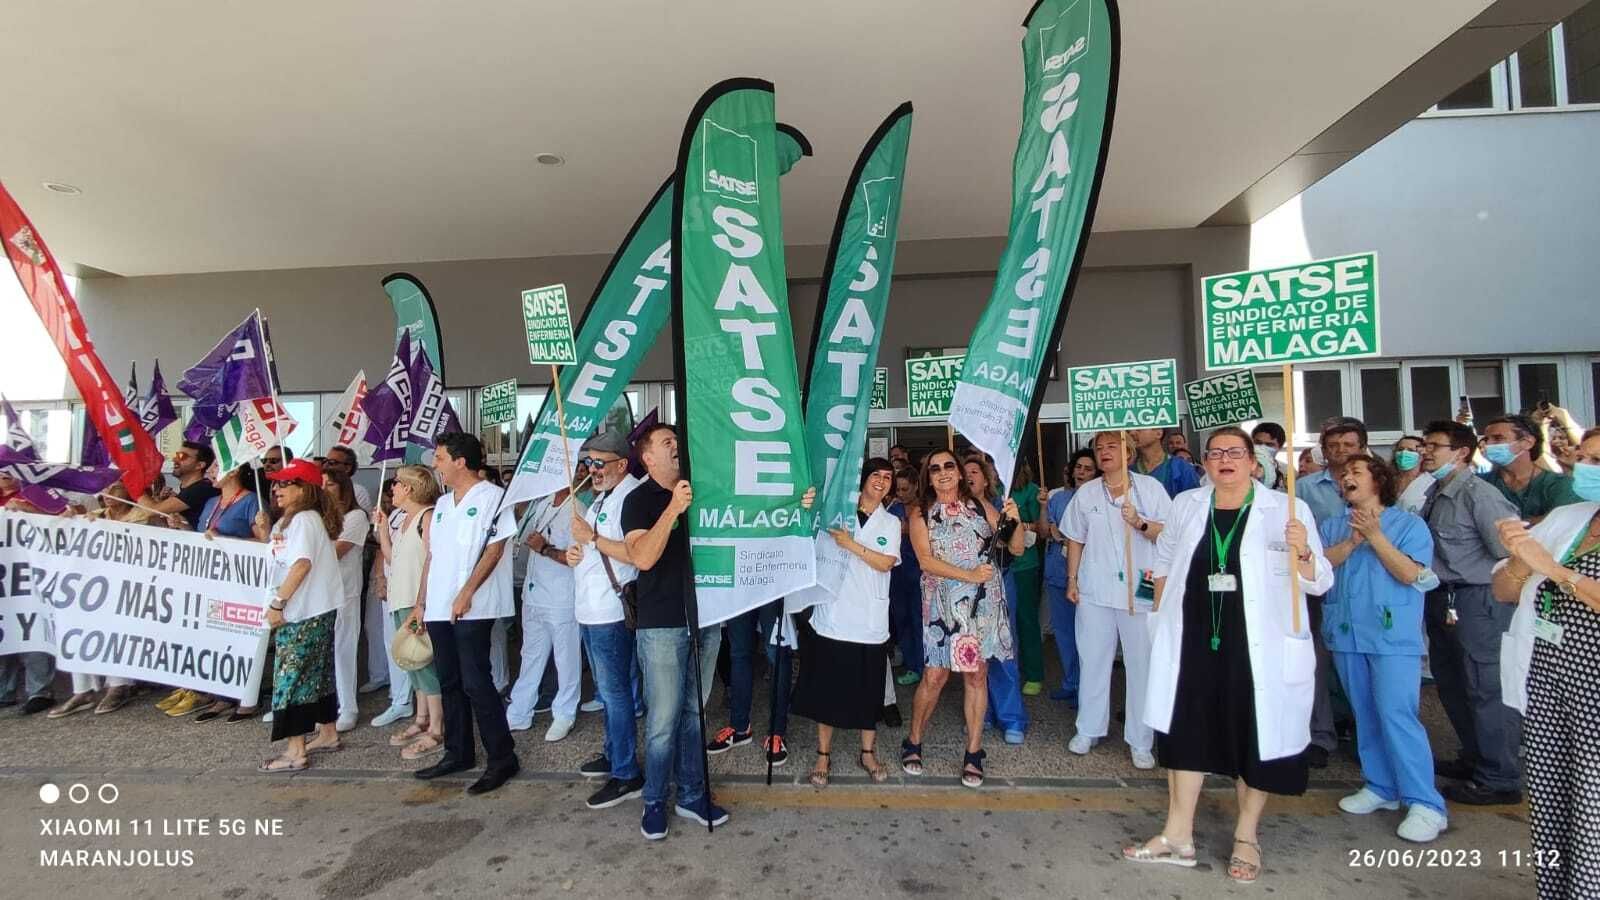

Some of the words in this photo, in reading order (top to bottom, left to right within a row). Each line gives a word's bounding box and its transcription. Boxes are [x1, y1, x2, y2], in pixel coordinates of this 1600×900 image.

[1211, 257, 1369, 310] SATSE
[525, 288, 567, 318] SATSE
[1211, 299, 1328, 326] SINDICATO
[1335, 293, 1368, 311] DE
[527, 318, 558, 330] SINDICATO
[558, 316, 568, 328] DE
[566, 239, 672, 408] ATSE
[1212, 310, 1369, 340] ENFERMERIA
[529, 329, 570, 342] ENFERMERIA
[1213, 327, 1369, 365] MALAGA
[530, 341, 573, 361] MALAGA
[711, 205, 795, 496] SATSE
[910, 359, 965, 381] SATS
[1074, 362, 1171, 391] SATSE
[483, 381, 515, 402] SATSE
[911, 380, 958, 391] SINDICA
[912, 390, 954, 400] ENFER
[1074, 388, 1148, 402] SINDICATO
[1151, 385, 1171, 397] DE
[1187, 370, 1253, 400] SATSE
[912, 400, 951, 416] MAL
[1075, 397, 1172, 412] ENFERMERIA
[1191, 391, 1239, 410] SINDICATO
[1240, 388, 1254, 398] DE
[1193, 397, 1256, 416] ENFERMERIA
[483, 411, 516, 426] MALAGA
[1076, 407, 1172, 429] MALAGA
[1195, 405, 1260, 430] MALAGA
[699, 505, 802, 529] MÁLAGA
[149, 539, 168, 572] DE
[171, 542, 232, 581] PRIMER
[234, 554, 268, 589] NIV
[694, 574, 733, 584] SATSE
[115, 575, 174, 624] MÁS
[181, 591, 202, 630] !!
[16, 612, 37, 641] Y
[61, 627, 253, 689] CONTRATACIÓN
